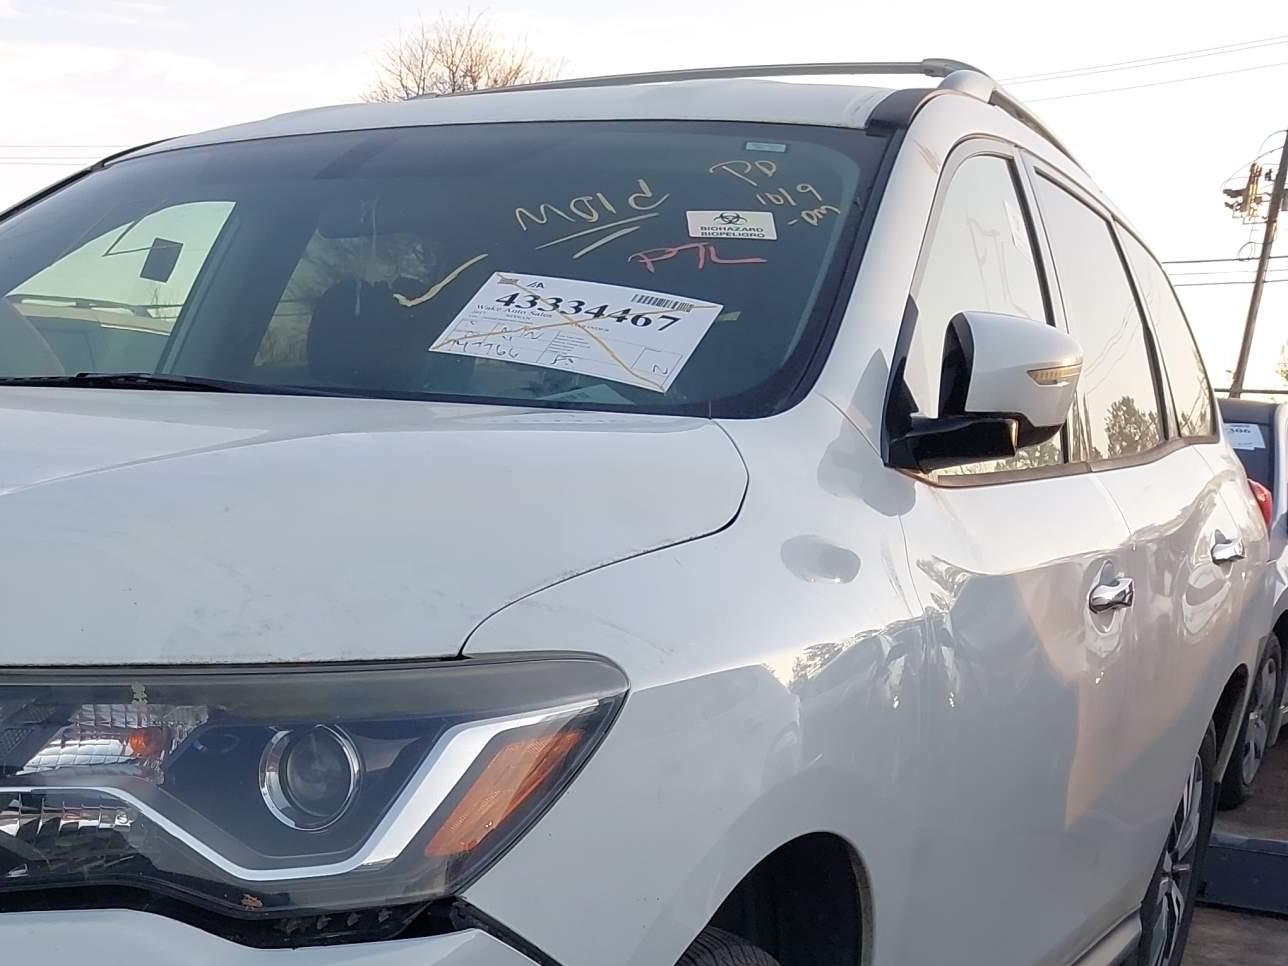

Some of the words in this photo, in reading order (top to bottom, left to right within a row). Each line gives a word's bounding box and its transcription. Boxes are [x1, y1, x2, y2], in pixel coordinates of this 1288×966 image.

[495, 292, 681, 331] 43334467
[504, 308, 527, 316] Auto
[530, 310, 553, 318] Sales
